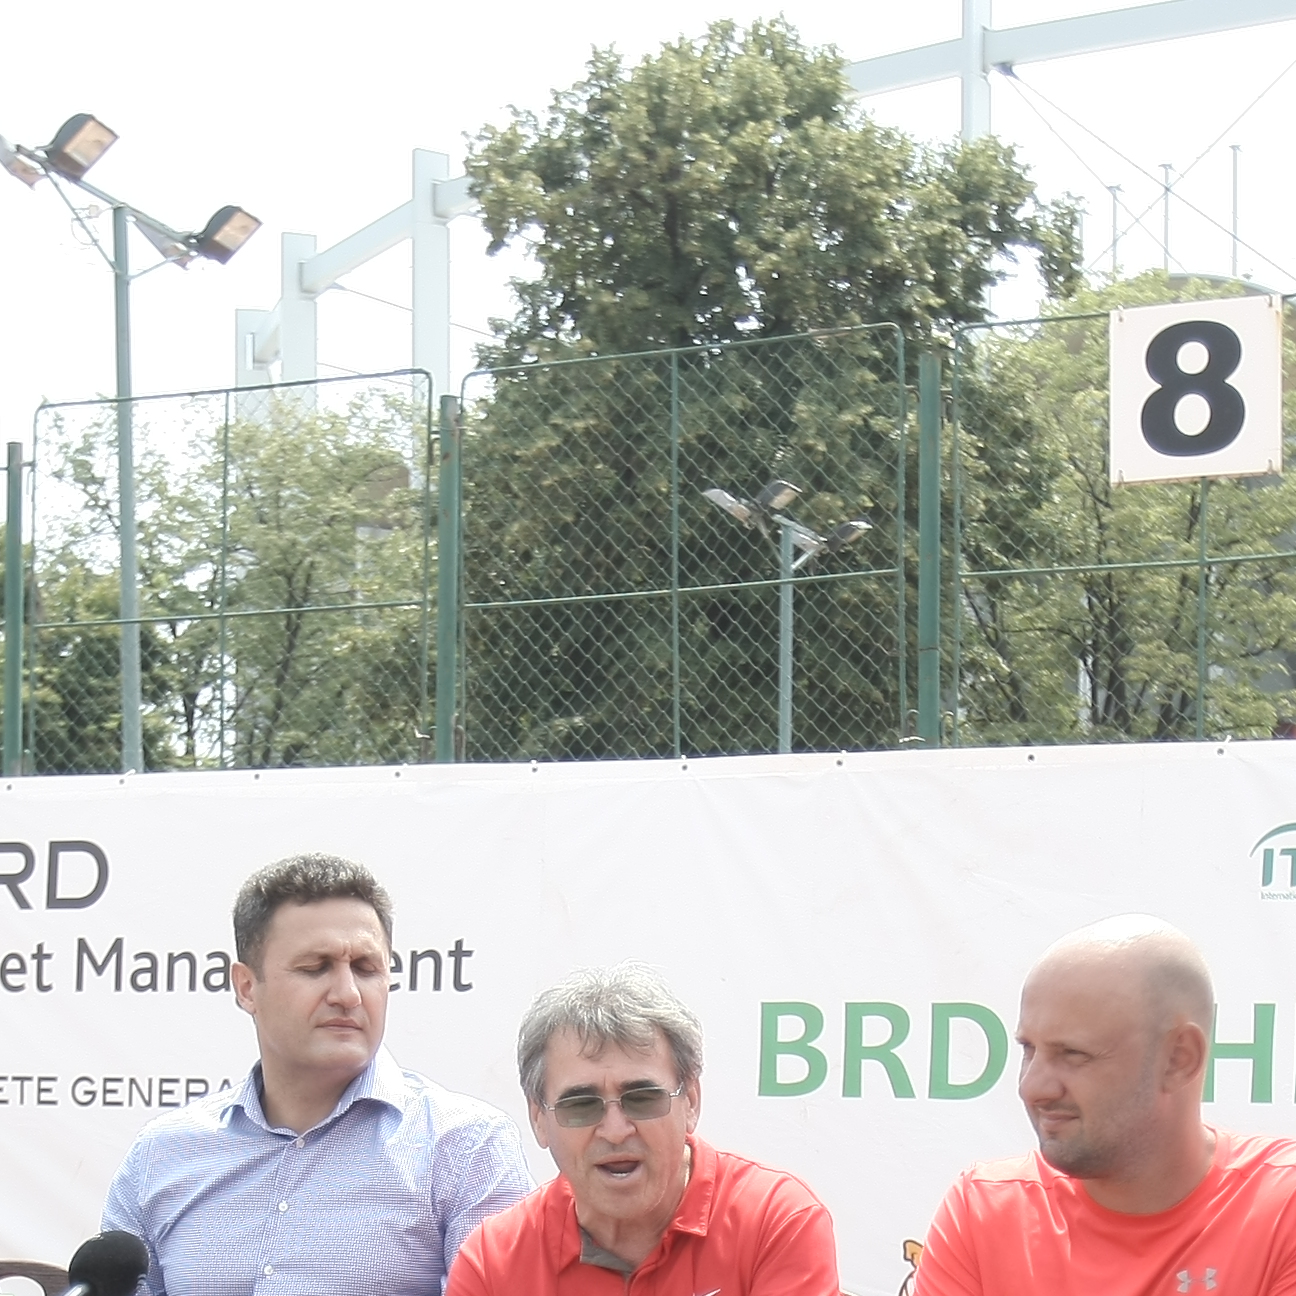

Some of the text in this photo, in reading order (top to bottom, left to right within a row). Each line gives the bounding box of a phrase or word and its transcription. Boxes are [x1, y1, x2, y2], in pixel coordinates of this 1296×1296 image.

[1141, 320, 1245, 457] 8
[75, 937, 475, 993] Manant
[758, 1001, 1008, 1100] BRD
[71, 1076, 232, 1107] GENER
